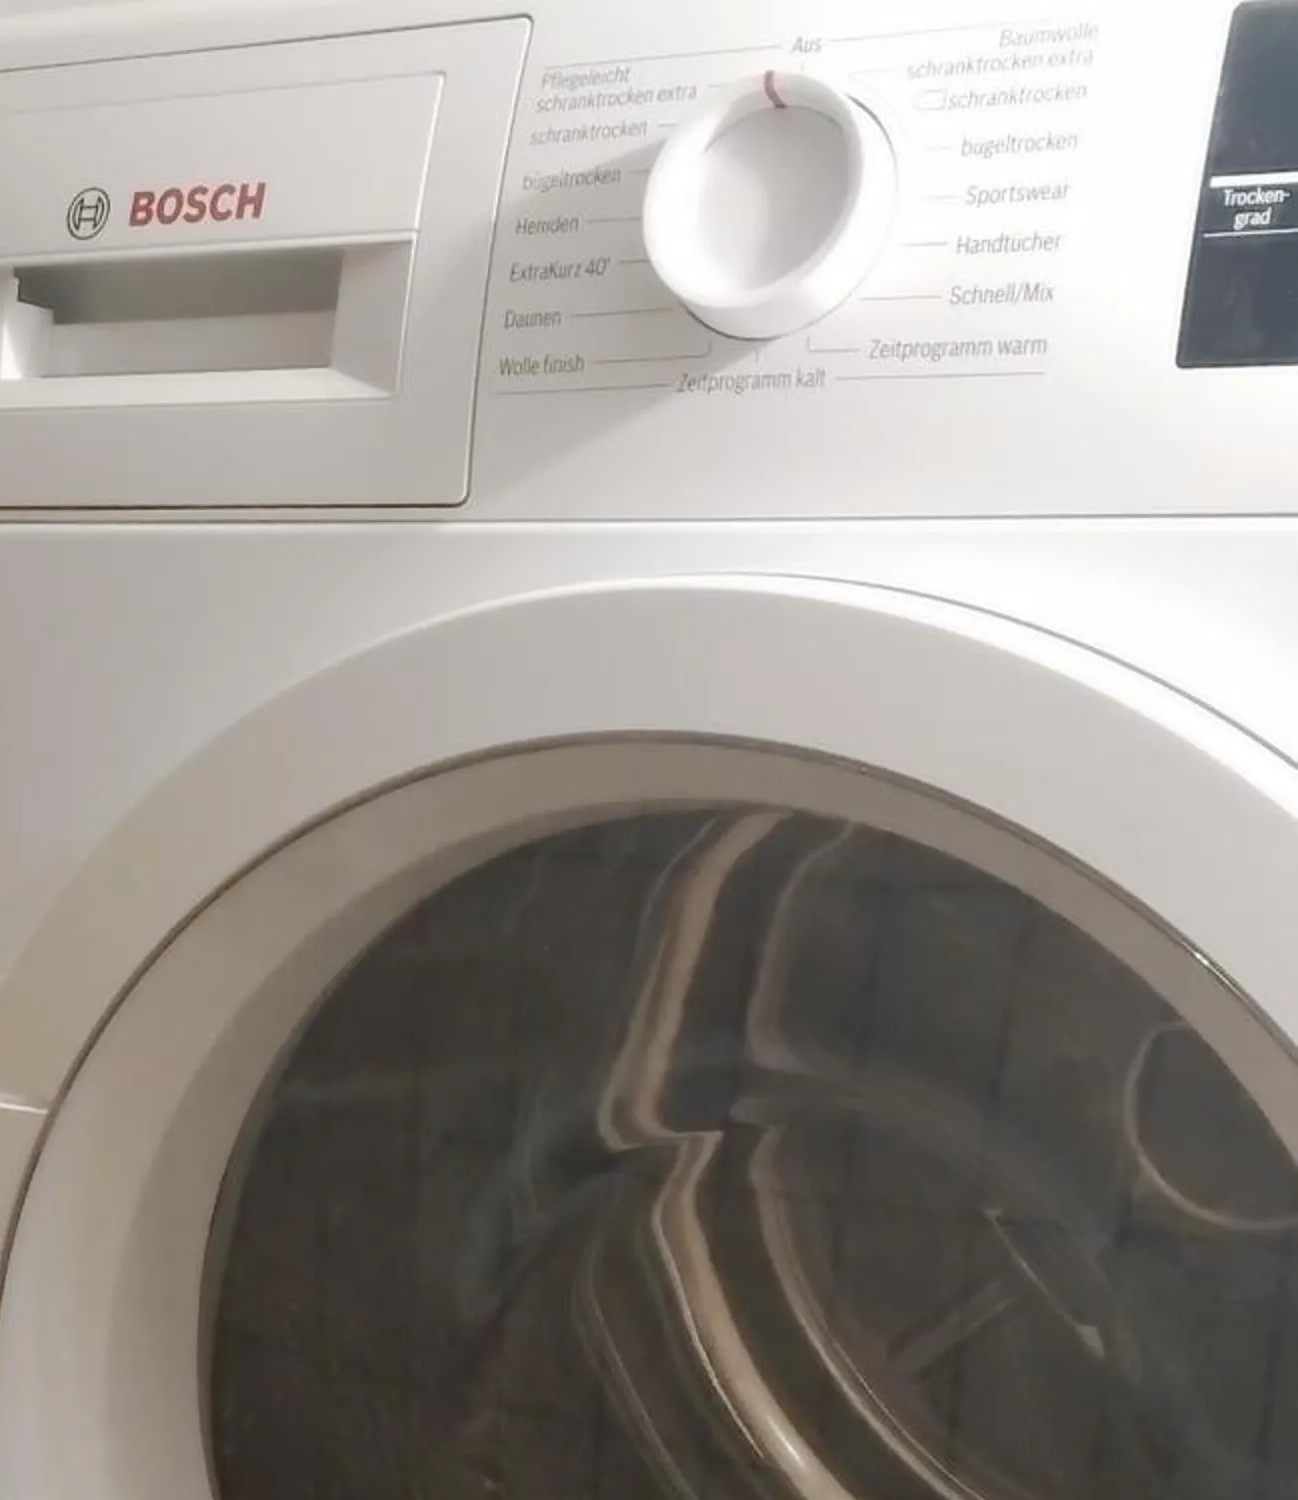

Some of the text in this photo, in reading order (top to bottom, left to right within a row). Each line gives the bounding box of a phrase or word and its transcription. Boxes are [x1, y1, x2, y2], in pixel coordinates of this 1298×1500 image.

[791, 36, 823, 53] Aus
[999, 22, 1099, 49] Baumwolle
[906, 47, 1095, 80] schranktrocken extra
[542, 66, 631, 92] Pflegeleicht
[535, 84, 698, 114] schranktrocken extra
[947, 82, 1087, 110] schranktrocken
[529, 119, 649, 146] schranktrocken
[129, 181, 266, 227] BOSCH
[965, 183, 1069, 208] Sportswear
[1222, 187, 1291, 207] Trocken-
[515, 216, 580, 235] Hemden
[1233, 207, 1273, 230] grad
[509, 260, 583, 283] ExtraKurz
[949, 282, 1055, 306] Schnell/Mix
[504, 309, 563, 330] Daunen
[868, 337, 1048, 362] Zeitprogramm warm
[499, 353, 585, 376] Wolle finish
[677, 367, 826, 395] Zeitprogramm kalt
